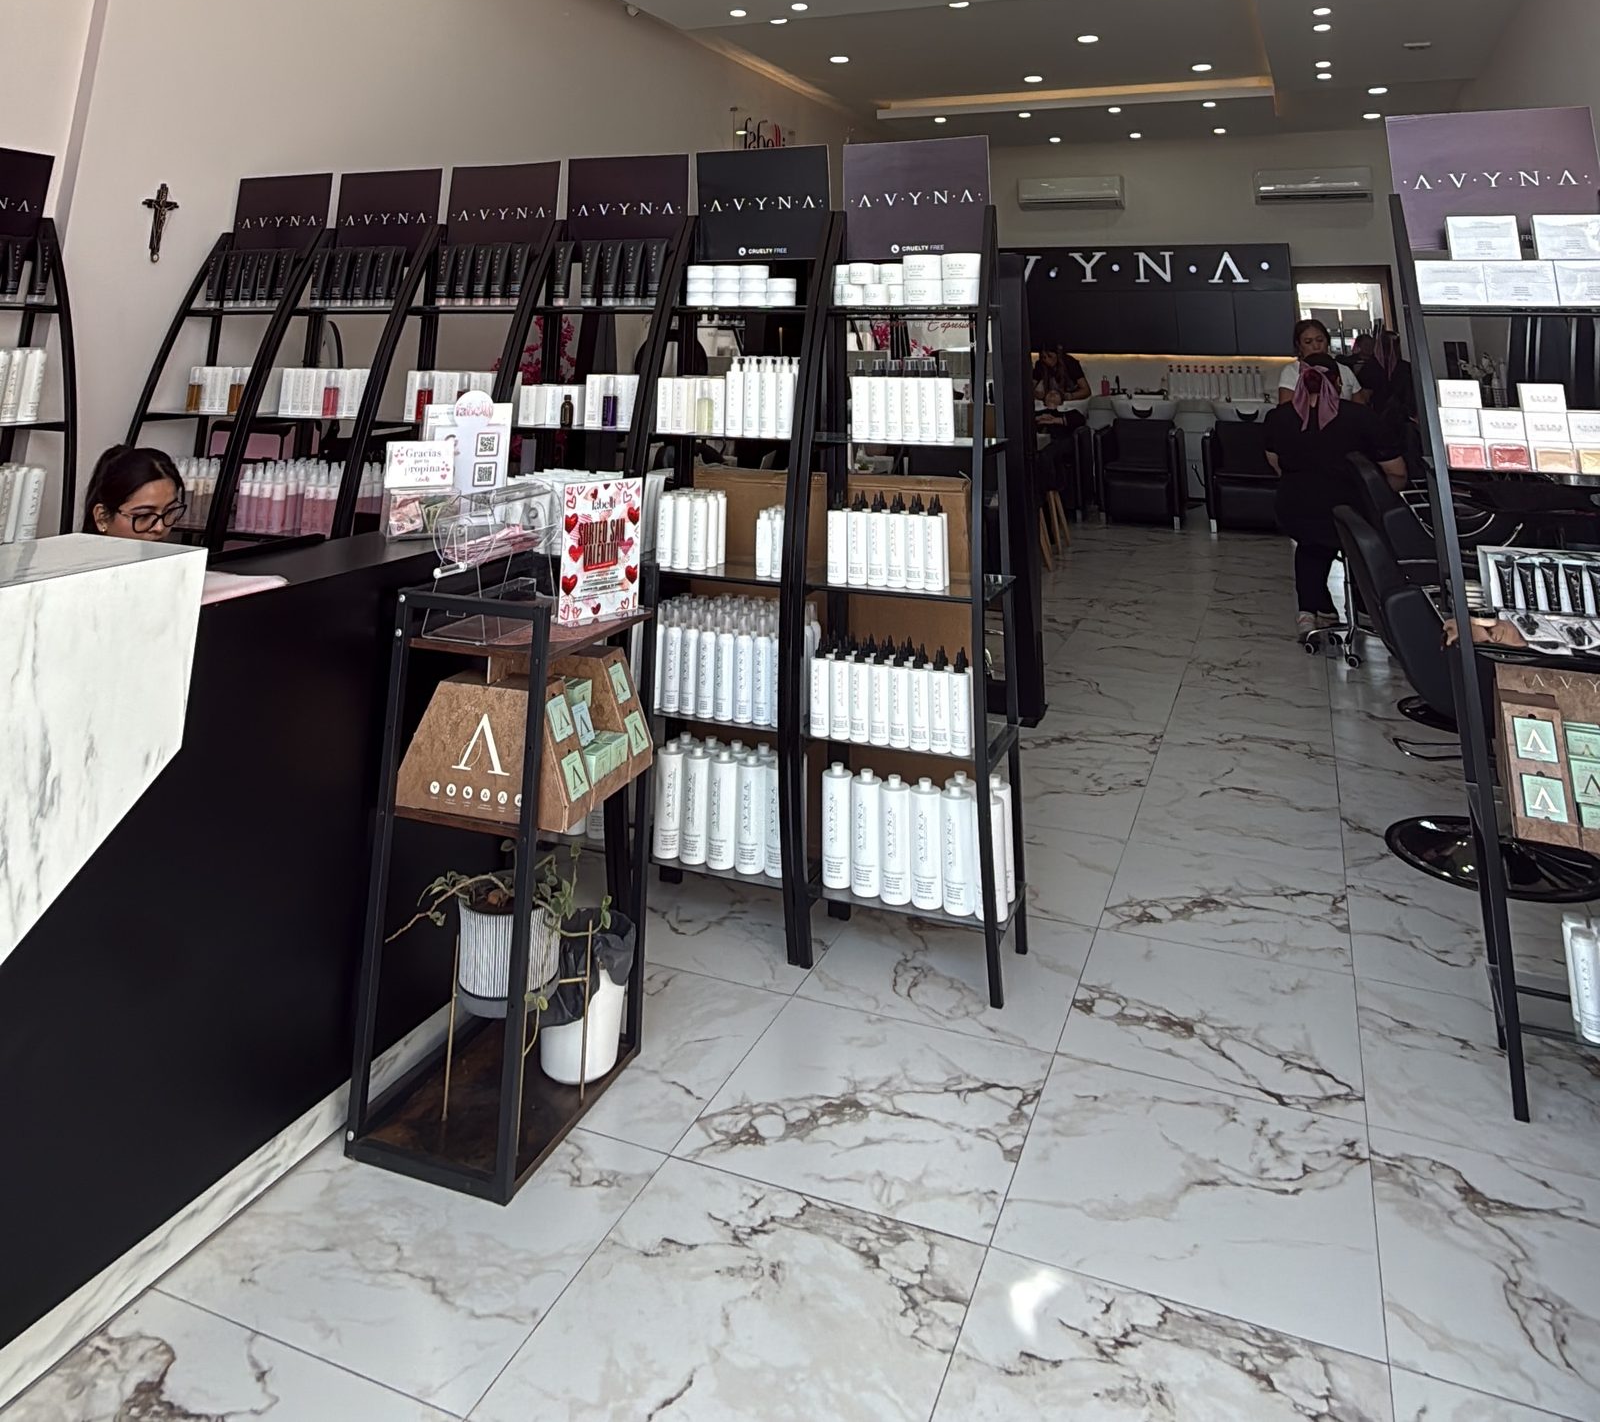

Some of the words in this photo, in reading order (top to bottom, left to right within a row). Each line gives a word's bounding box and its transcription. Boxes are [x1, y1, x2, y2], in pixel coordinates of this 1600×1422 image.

[405, 448, 442, 458] Gracias
[404, 465, 441, 475] propina
[578, 520, 608, 546] SORTEO
[610, 518, 625, 542] SAN
